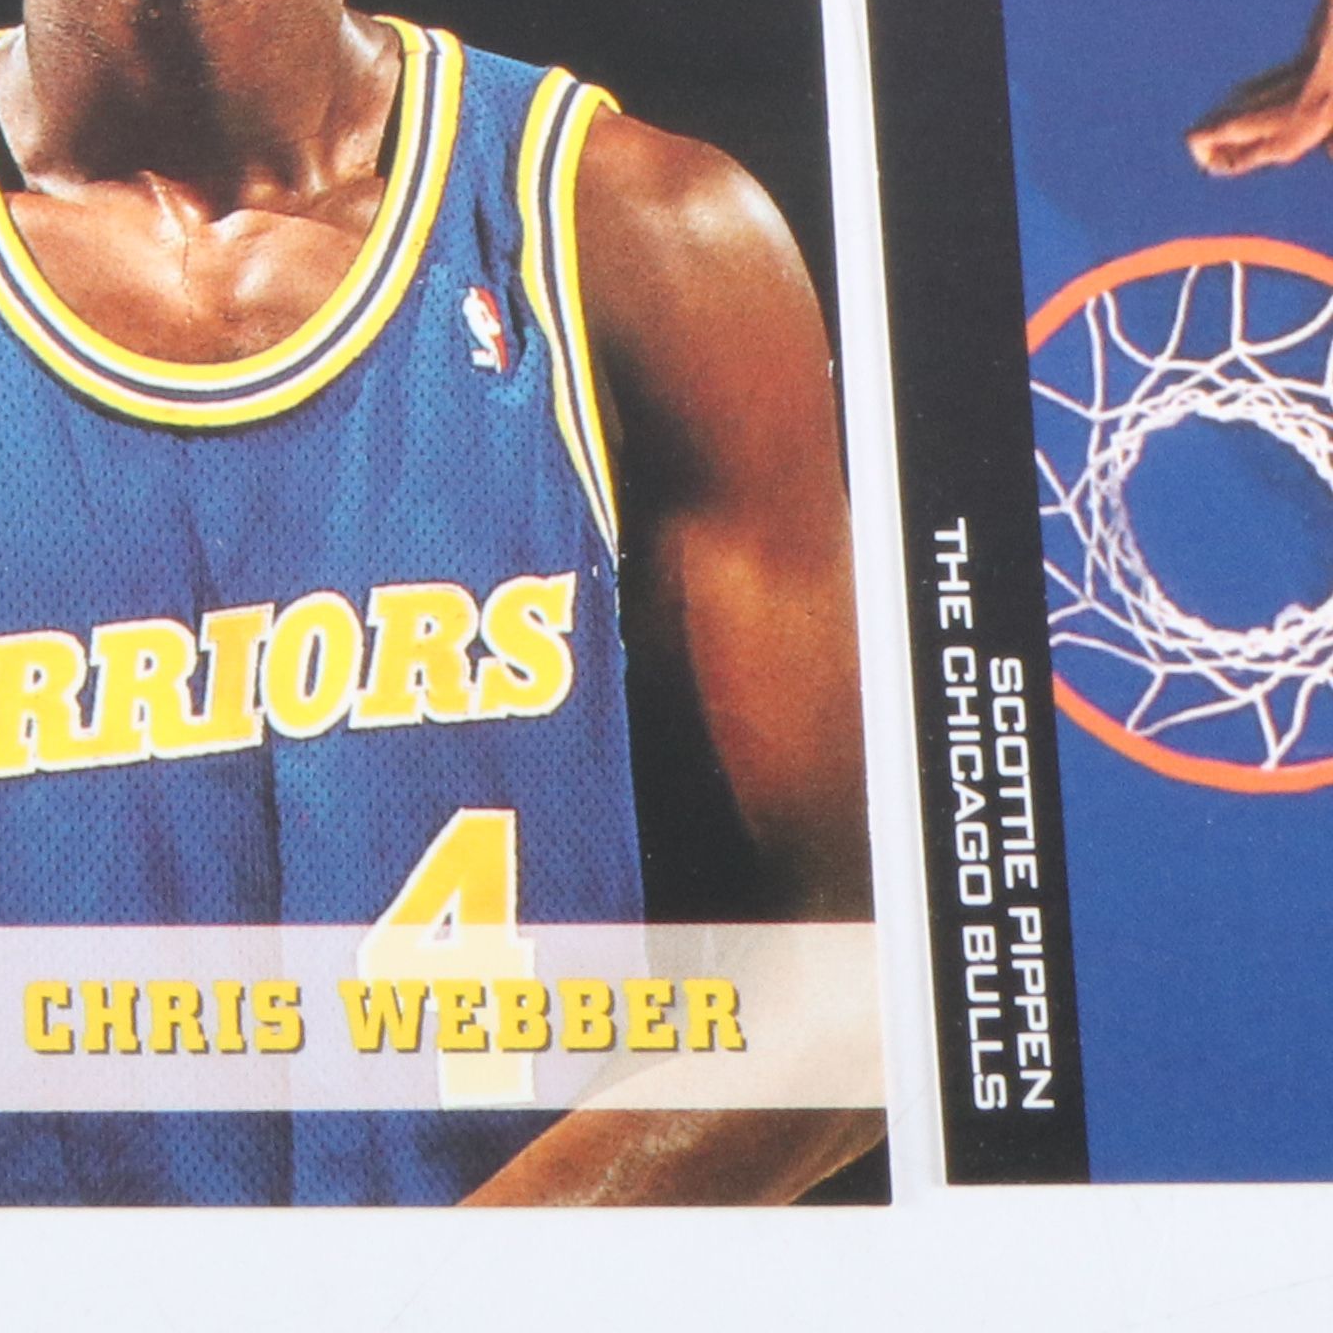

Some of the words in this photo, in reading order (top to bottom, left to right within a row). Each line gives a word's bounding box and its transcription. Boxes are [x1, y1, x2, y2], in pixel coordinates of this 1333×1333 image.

[934, 517, 974, 630] THE
[942, 645, 994, 907] CHICAGO
[989, 655, 1040, 890] SCOTTIE
[21, 978, 306, 1055] CHRIS
[335, 977, 748, 1056] WEBBER
[356, 807, 535, 1110] 4
[962, 923, 1008, 1112] BULLS
[1008, 905, 1055, 1112] PIPPEN
